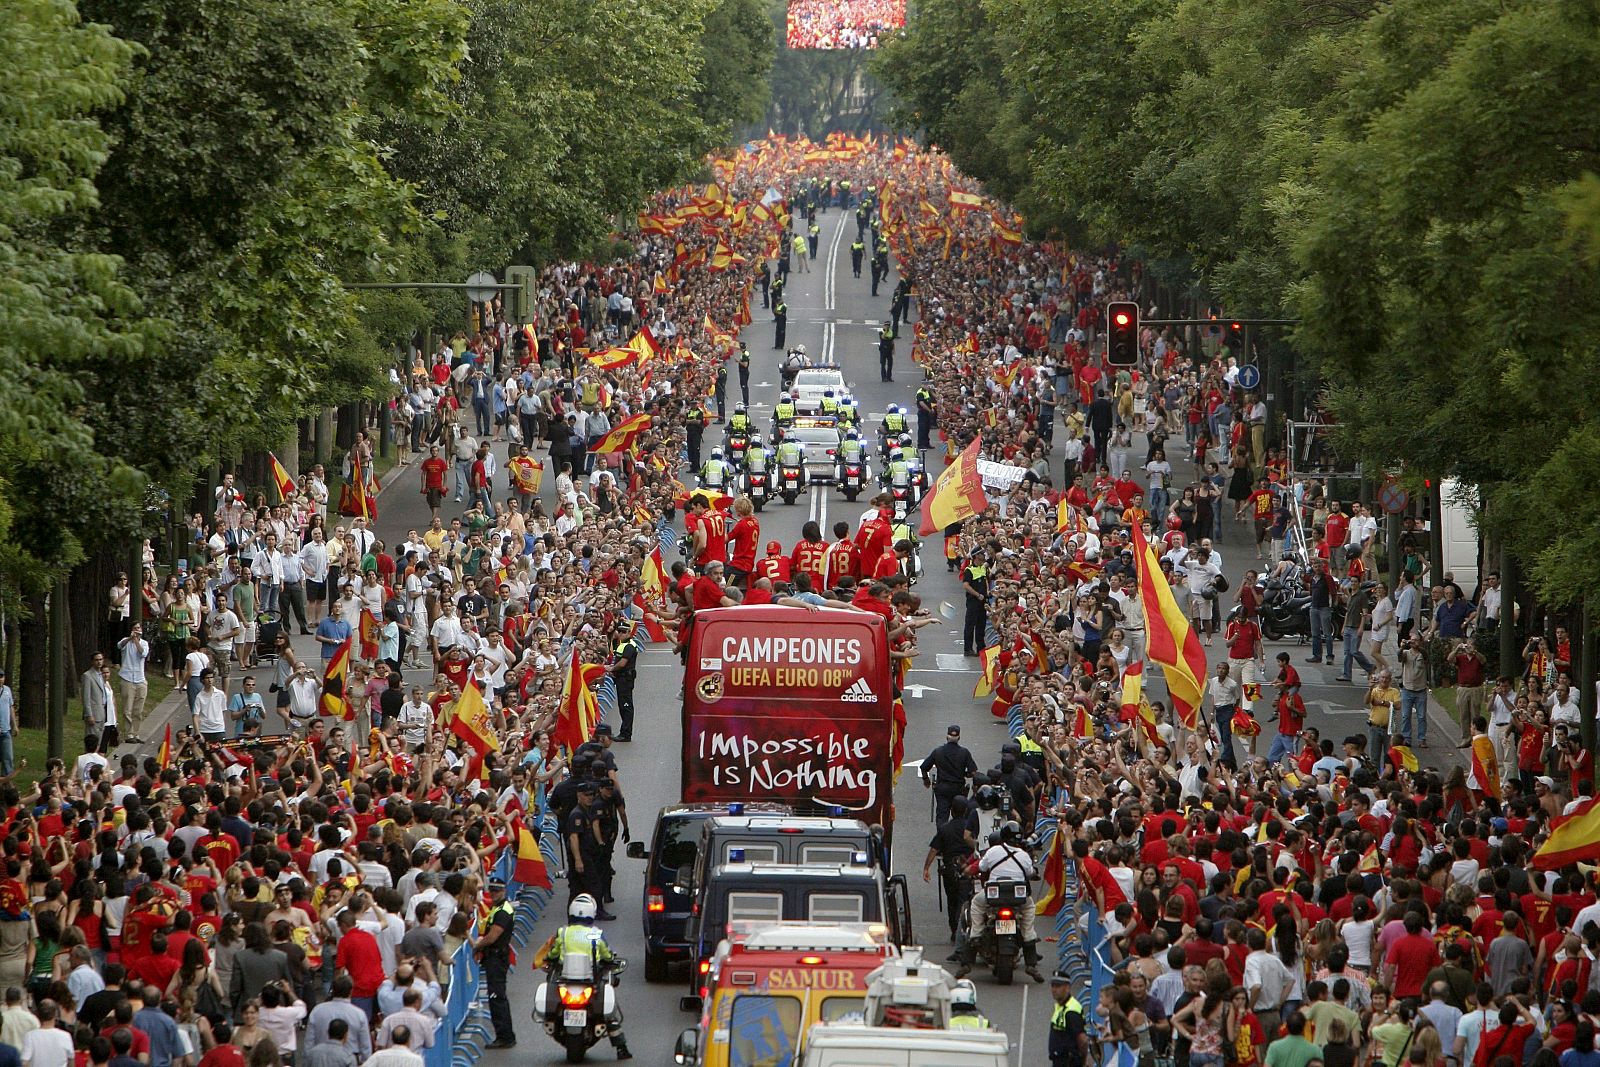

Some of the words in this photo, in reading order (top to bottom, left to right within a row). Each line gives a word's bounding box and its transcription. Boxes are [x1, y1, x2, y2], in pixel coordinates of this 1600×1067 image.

[977, 461, 1023, 480] SENNA
[709, 516, 724, 538] 10
[864, 528, 875, 549] 7
[764, 560, 780, 579] 2
[800, 551, 823, 572] 22
[832, 552, 850, 574] 18
[722, 636, 861, 664] CAMPEONES
[731, 667, 771, 687] UEFA
[775, 668, 818, 687] EURO
[840, 693, 878, 703] adidas
[749, 758, 877, 811] Nothing
[1536, 906, 1550, 924] 7
[768, 968, 856, 989] SAMUR
